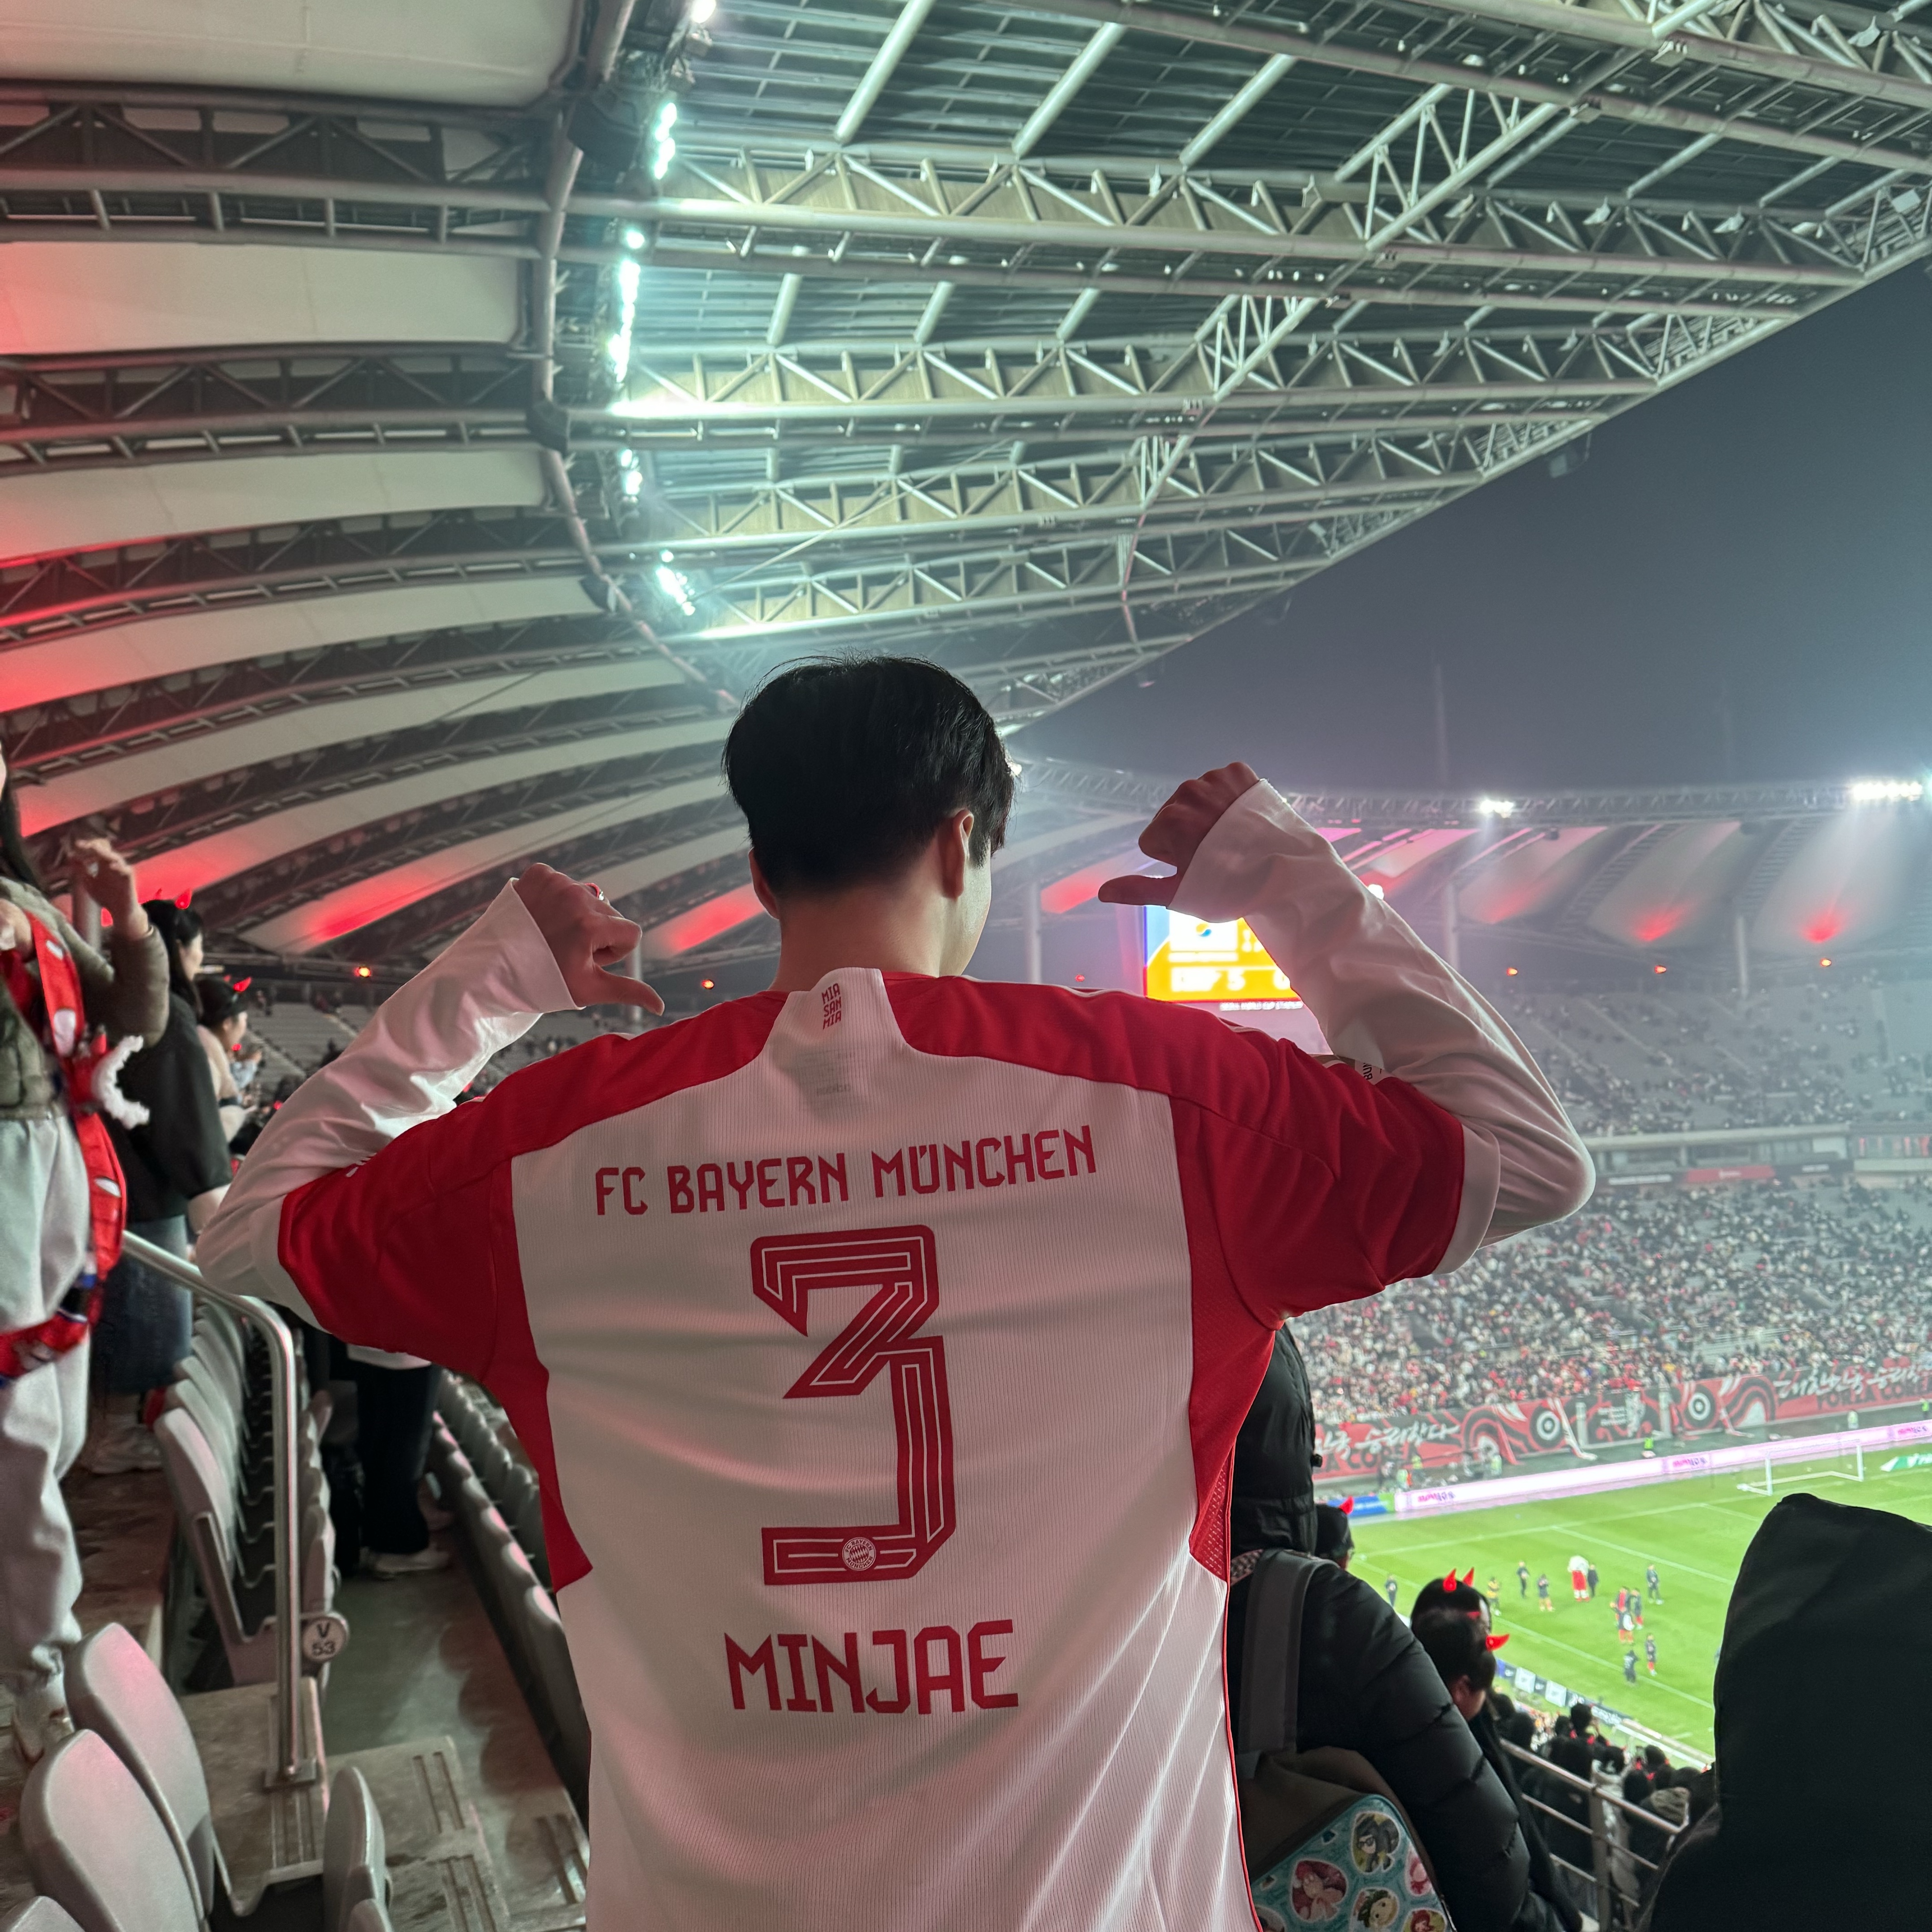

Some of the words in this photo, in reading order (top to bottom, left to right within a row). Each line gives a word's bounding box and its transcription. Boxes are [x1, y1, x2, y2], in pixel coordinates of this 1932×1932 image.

[822, 983, 841, 1005] MIA
[823, 997, 842, 1017] SAN
[823, 1010, 842, 1030] MIA
[595, 1167, 648, 1215] FC
[667, 1152, 850, 1214] BAYERN
[871, 1125, 1097, 1198] MÜNCHEN
[750, 1224, 956, 1585] 3
[851, 1539, 873, 1551] BAYERN
[317, 1622, 331, 1638] V
[724, 1619, 1019, 1714] MINJAE
